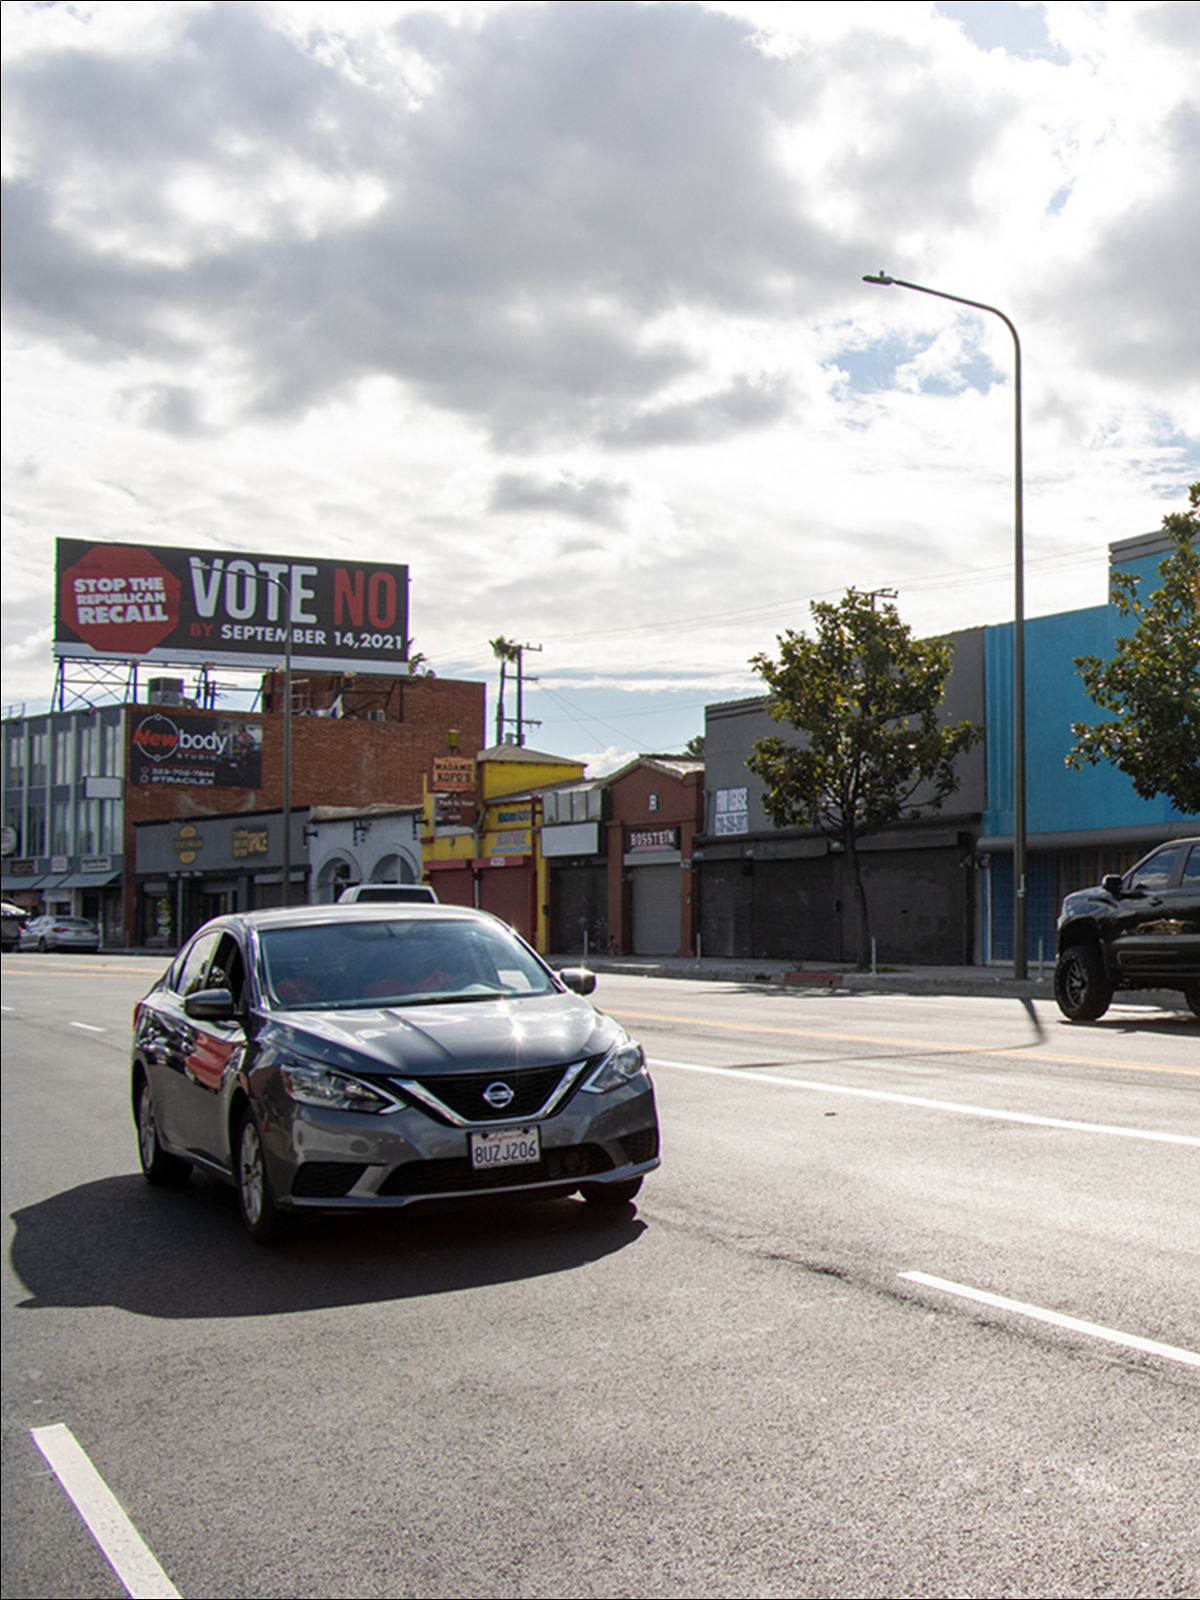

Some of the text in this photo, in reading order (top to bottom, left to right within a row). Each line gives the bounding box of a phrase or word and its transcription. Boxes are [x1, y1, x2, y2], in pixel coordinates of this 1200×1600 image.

[73, 577, 164, 593] STOP THE
[189, 556, 397, 629] VOTE NO
[76, 592, 166, 605] REPUBLICAN
[77, 604, 169, 624] RECALL
[190, 622, 402, 649] BY SEPTEMBER 14,2021
[435, 763, 473, 772] MADAME
[437, 772, 472, 782] KOFO'S
[474, 1140, 538, 1164] 8UZJ206
